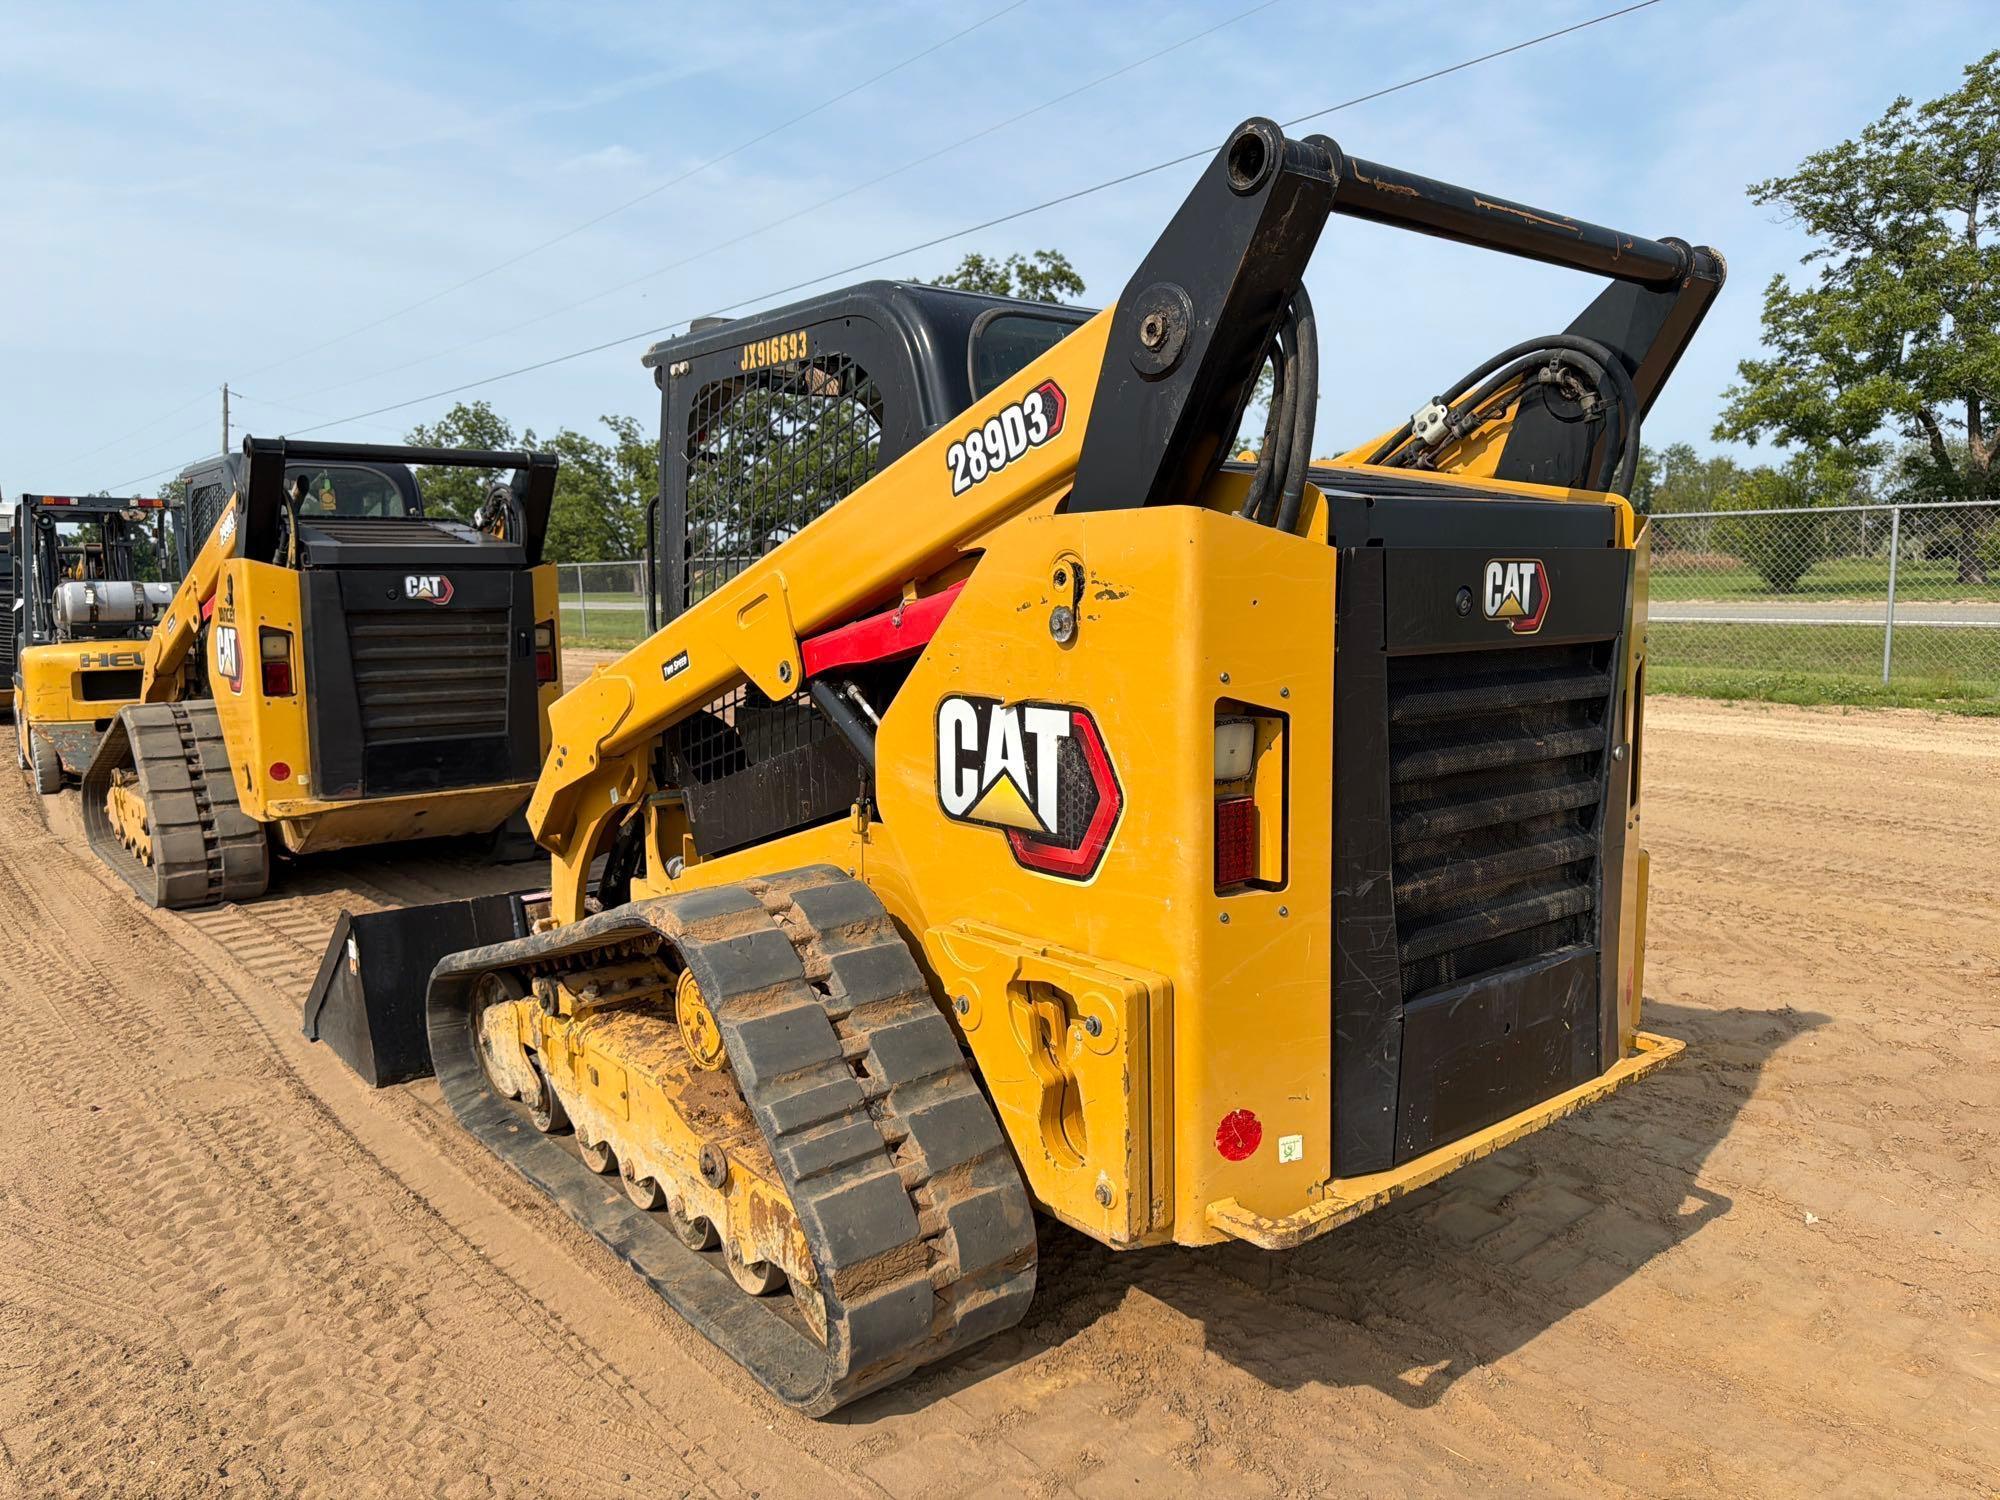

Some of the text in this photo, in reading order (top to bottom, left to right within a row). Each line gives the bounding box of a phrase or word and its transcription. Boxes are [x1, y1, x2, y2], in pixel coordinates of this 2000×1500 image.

[741, 331, 807, 371] JX916693
[947, 392, 1048, 494] 289D3
[405, 576, 441, 598] CAT
[1484, 562, 1535, 616] CAT
[216, 627, 237, 677] CAT
[939, 698, 1072, 834] CAT
